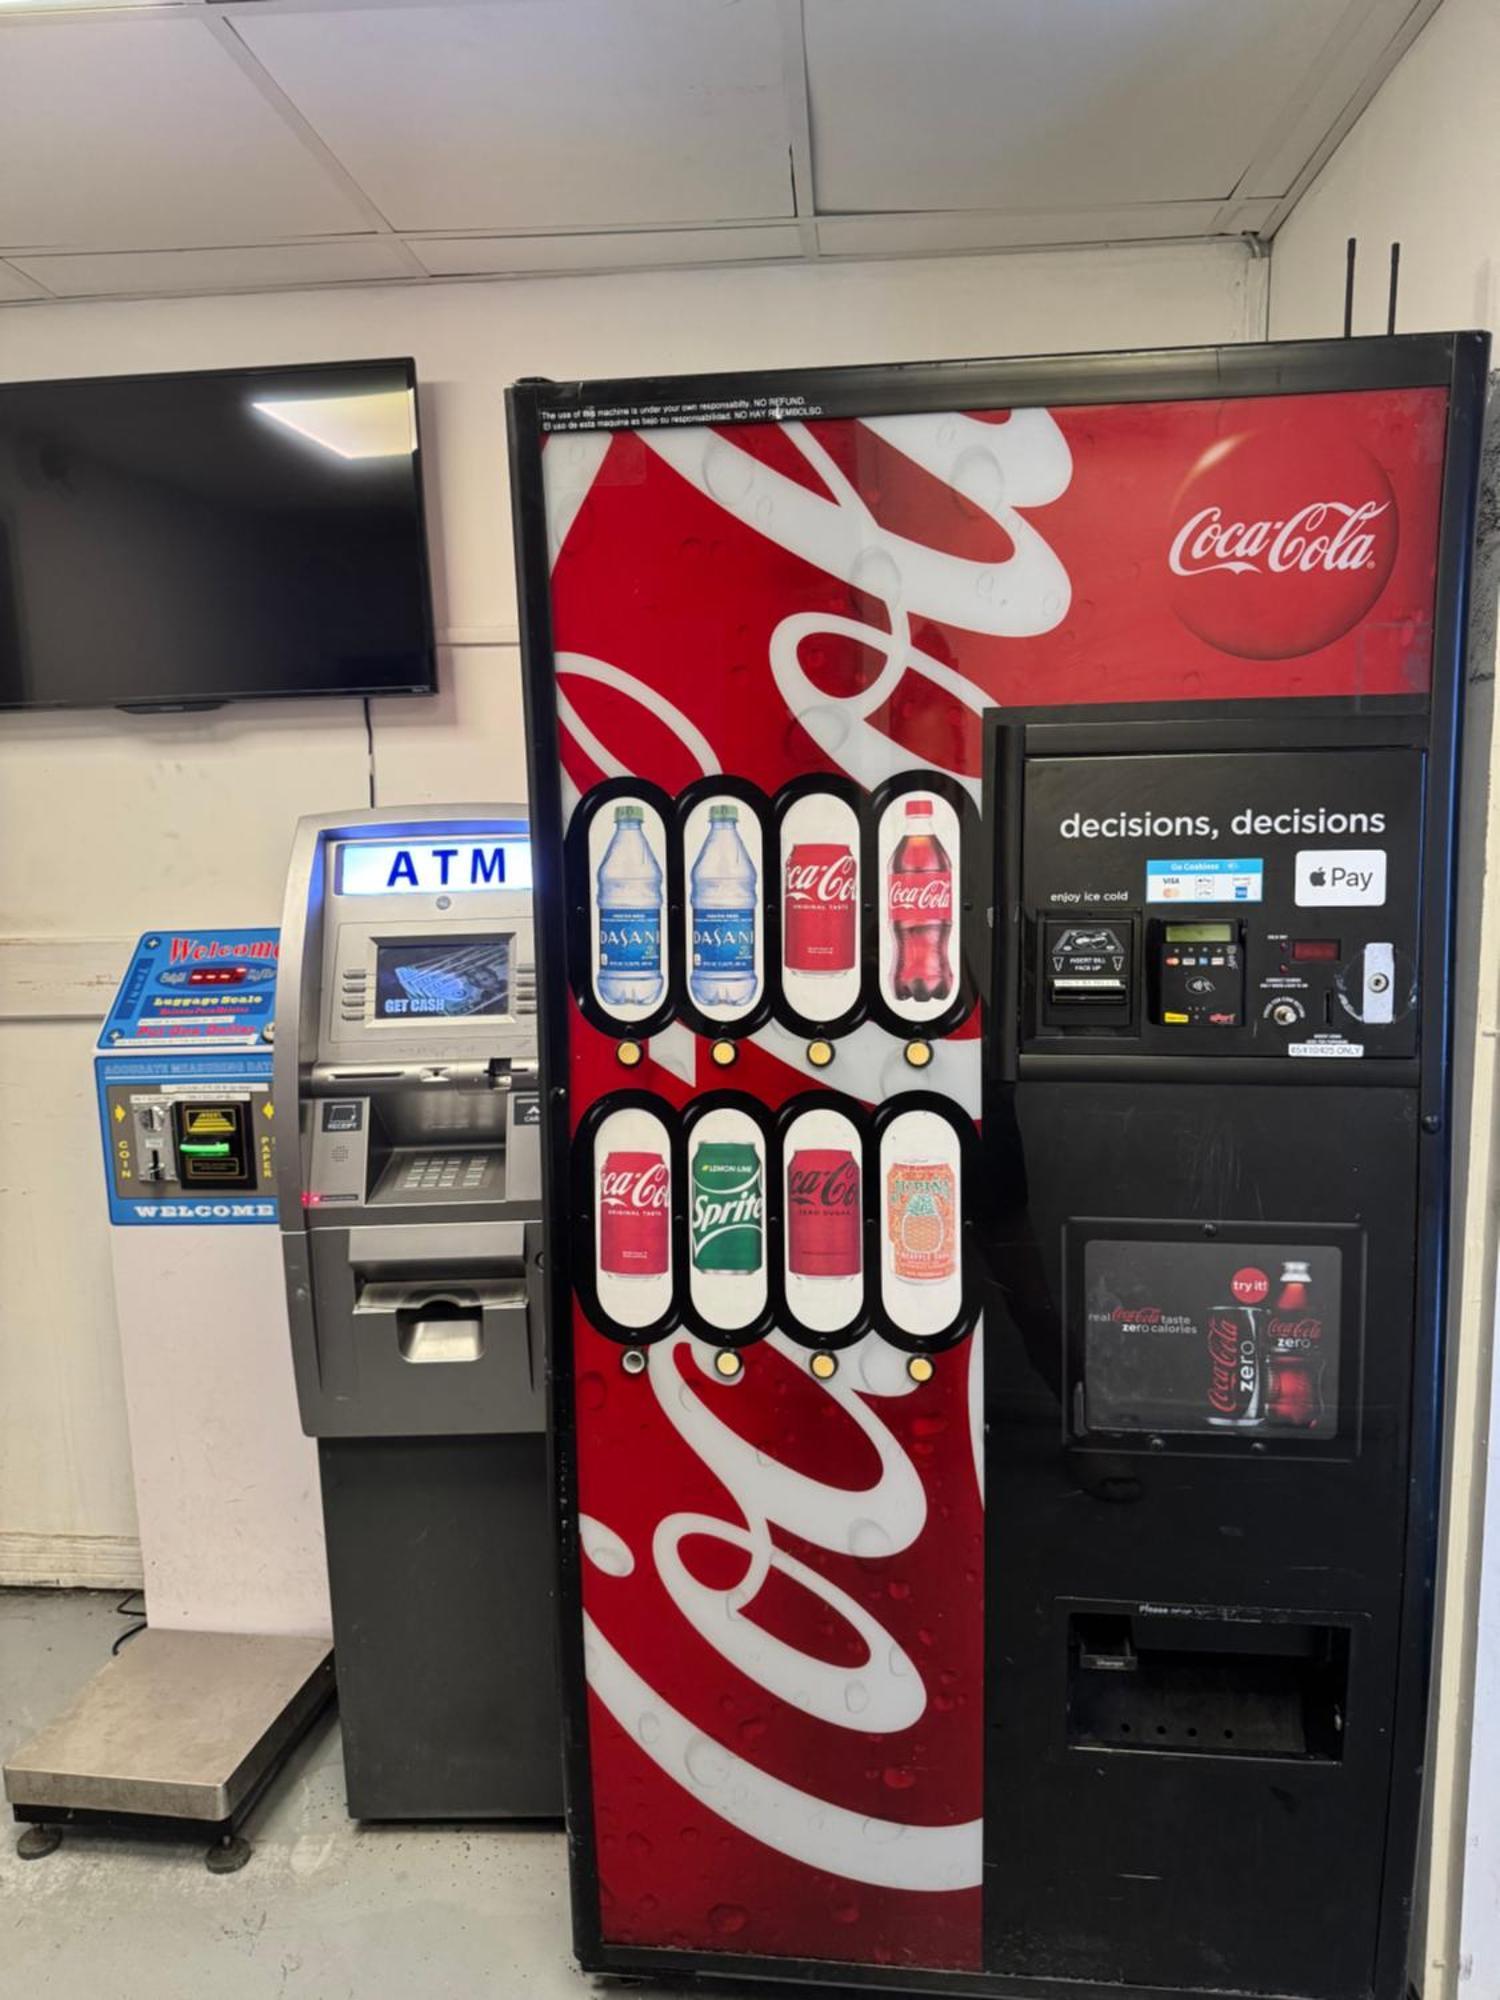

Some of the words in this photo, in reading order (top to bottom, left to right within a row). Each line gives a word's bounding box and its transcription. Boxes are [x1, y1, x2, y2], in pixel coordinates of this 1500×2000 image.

[542, 411, 556, 420] The
[573, 410, 581, 418] of
[598, 407, 630, 416] machine
[640, 405, 661, 414] under
[663, 405, 680, 414] your
[753, 398, 767, 407] NO
[543, 421, 552, 431] El
[568, 421, 578, 429] de
[579, 420, 596, 429] esta
[641, 417, 659, 426] bajo
[734, 410, 748, 419] NO
[749, 409, 767, 418] HAY
[1169, 501, 1391, 576] Coca-Cola
[1060, 811, 1220, 840] decisions,
[1231, 808, 1386, 835] decisions
[387, 847, 505, 887] ATM
[1162, 877, 1180, 885] VISA
[1331, 867, 1373, 892] Pay
[889, 880, 950, 910] Coca-Cola
[1050, 892, 1081, 904] enjoy
[1084, 892, 1101, 901] ice
[1103, 891, 1129, 901] cold
[600, 928, 660, 946] DASANI
[693, 928, 753, 946] DASANI
[154, 996, 219, 1007] Luggage
[220, 995, 263, 1004] Scale
[384, 998, 408, 1013] GET
[410, 998, 445, 1012] CASH
[1336, 1046, 1360, 1055] ONLY
[327, 1122, 357, 1130] RECEIPT
[118, 1140, 132, 1179] COIN
[134, 1204, 275, 1218] WELCOME
[693, 1192, 763, 1232] Sprite
[1233, 1280, 1252, 1292] try
[1253, 1279, 1268, 1291] it!
[1088, 1312, 1111, 1322] real
[1112, 1306, 1162, 1323] Coca-Cola
[1161, 1315, 1191, 1324] taste
[1121, 1323, 1150, 1333] zero
[1151, 1324, 1197, 1334] calories
[1269, 1318, 1322, 1339] Coca-Cola
[1277, 1336, 1310, 1349] zero
[1208, 1317, 1238, 1412] Coca-Cola
[1240, 1340, 1255, 1392] zero
